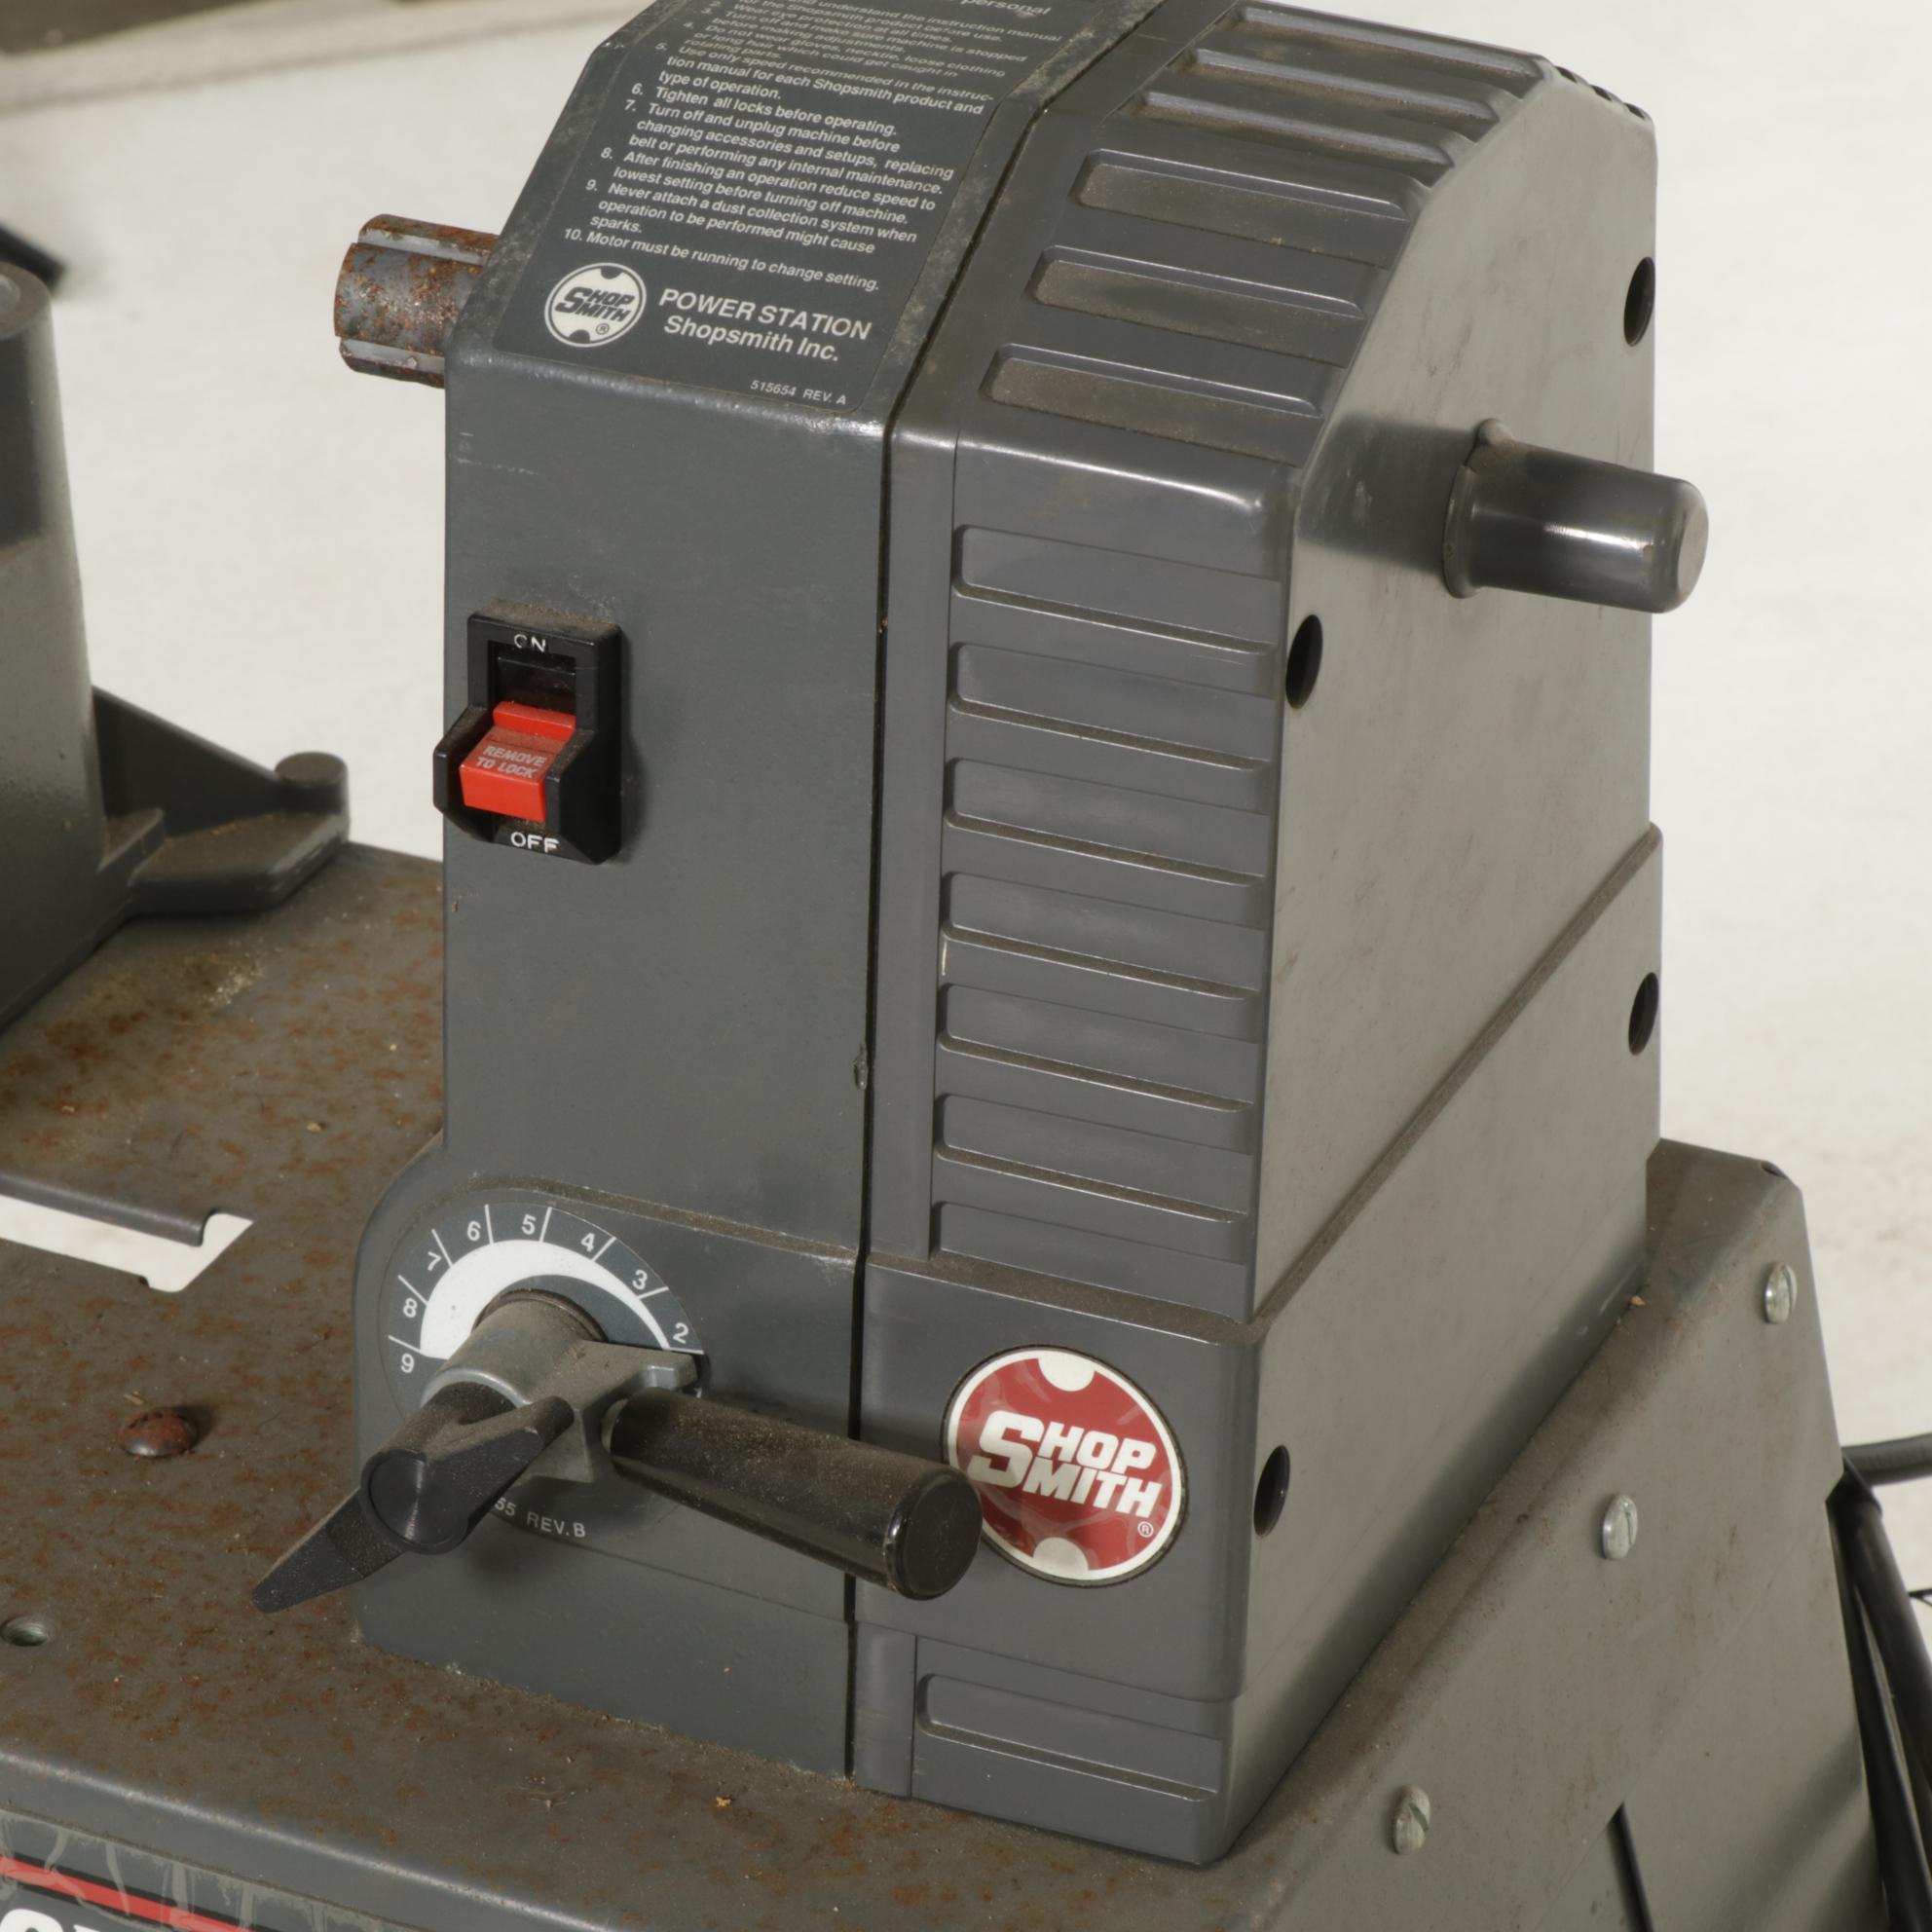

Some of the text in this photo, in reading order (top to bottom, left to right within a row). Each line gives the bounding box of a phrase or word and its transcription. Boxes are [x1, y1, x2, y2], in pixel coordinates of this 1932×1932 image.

[733, 3, 769, 14] Wear
[771, 11, 798, 19] eye
[798, 15, 872, 30] protection
[910, 31, 954, 42] times.
[762, 0, 785, 9] the
[787, 4, 864, 21] Shopsmith
[864, 18, 923, 30] product
[818, 1, 901, 18] understand
[926, 17, 1005, 33] instruction
[1007, 29, 1062, 42] manual
[960, 0, 1052, 16] personal
[712, 18, 759, 29] before
[761, 25, 813, 39] making
[725, 11, 758, 20] Turn
[780, 20, 810, 29] and
[810, 25, 850, 35] make
[851, 31, 884, 41] sure
[886, 37, 948, 50] machine
[965, 49, 1027, 62] stopped
[684, 39, 783, 58] rotating parts.
[712, 34, 745, 45] long
[746, 39, 775, 49] hair
[777, 45, 820, 56] which
[822, 53, 865, 63] could
[864, 58, 890, 67] get
[891, 63, 943, 75] caught
[755, 33, 790, 43] wear
[790, 39, 840, 52] gloves,
[845, 48, 900, 60] necktie,
[904, 56, 945, 67] loose
[947, 62, 1005, 77] clothing
[658, 70, 784, 99] type of operation.
[667, 56, 985, 114] tion manual for each Shopsmith product and
[679, 46, 707, 56] Use
[708, 52, 741, 63] only
[742, 57, 788, 69] speed
[788, 64, 894, 86] recommended
[894, 80, 910, 89] in
[911, 83, 936, 93] the
[937, 87, 993, 101] instruc-
[631, 83, 898, 137] 6. Tighten all locks before operating.
[625, 99, 900, 153] 7. Turn off and unplug machine before
[628, 134, 946, 194] belt or performing any internal maintenance.
[637, 119, 954, 181] changing accessories and setups, replacing
[601, 147, 936, 210] 8. After finishing an operation reduce speed to
[613, 167, 910, 223] lowest setting before turning off machine.
[585, 179, 917, 242] 9. Never attach a dust collection system when
[590, 216, 645, 233] sparks.
[598, 201, 875, 253] operation to be performed might cause
[565, 228, 881, 292] 10. Motor must be running to change setting.
[658, 288, 872, 340] POWER STATION
[664, 315, 839, 361] Shopsmith Inc.
[750, 379, 847, 405] 515654 REV. A
[513, 634, 546, 652] ON
[475, 757, 539, 778] TO LOCK
[483, 745, 546, 767] REMOVE
[510, 832, 560, 853] OFF
[466, 1220, 481, 1242] 6
[521, 1213, 537, 1235] 5
[580, 1232, 595, 1251] 4
[427, 1251, 442, 1271] 7
[632, 1269, 648, 1290] 3
[402, 1297, 418, 1319] 8
[672, 1322, 688, 1344] 2
[400, 1353, 415, 1373] 9
